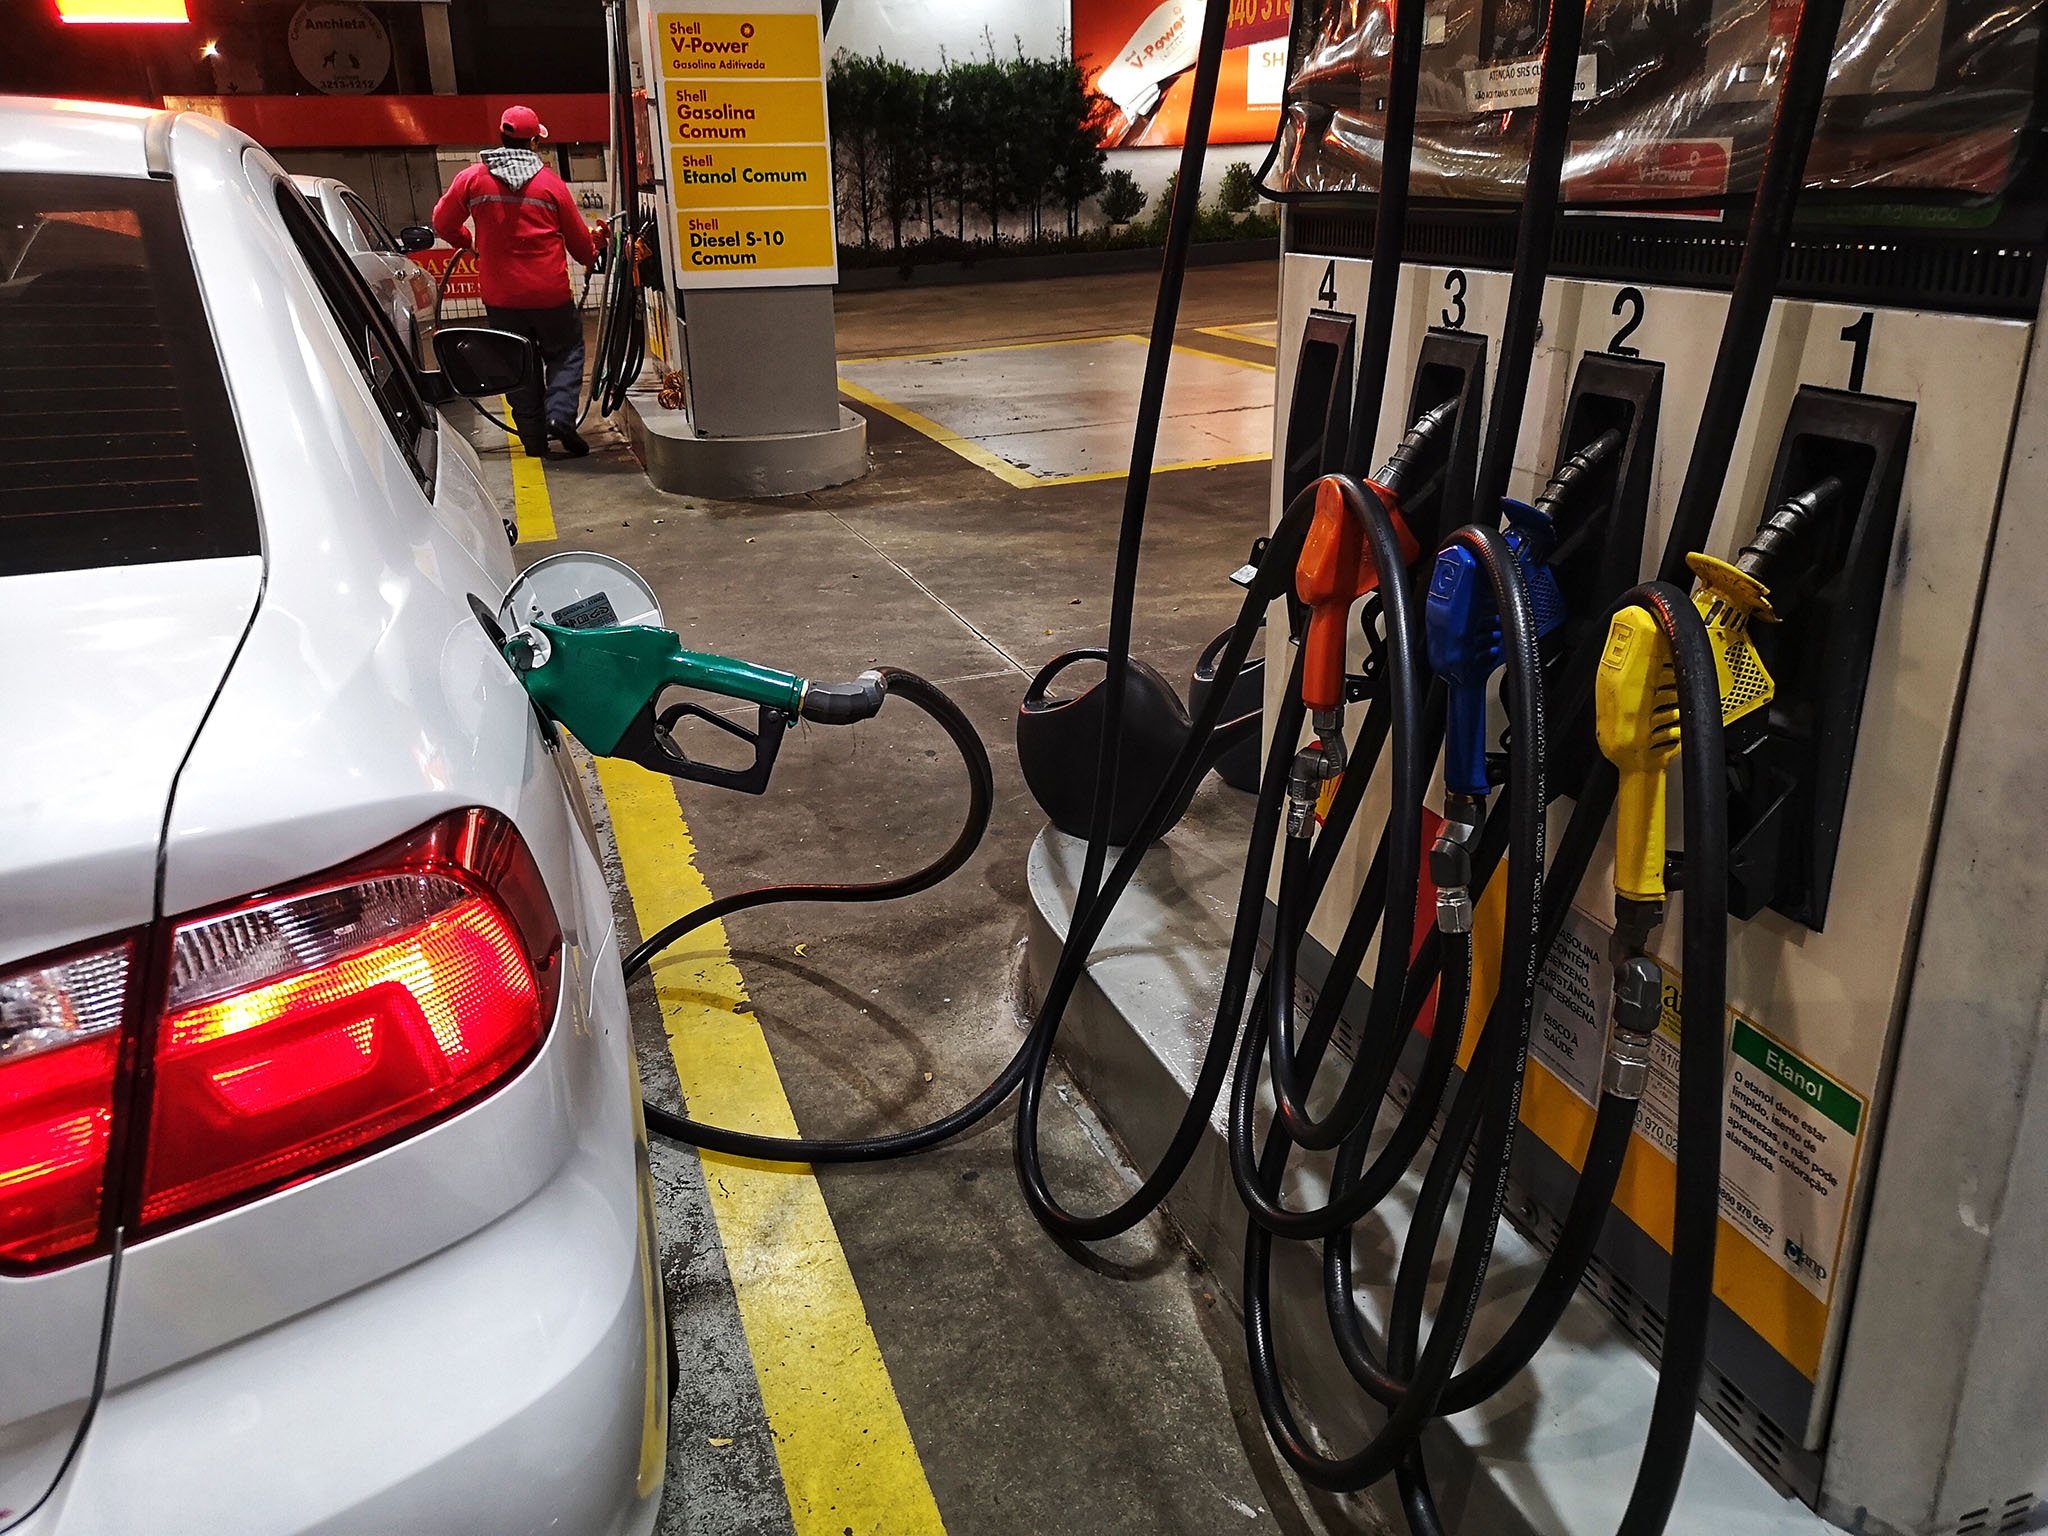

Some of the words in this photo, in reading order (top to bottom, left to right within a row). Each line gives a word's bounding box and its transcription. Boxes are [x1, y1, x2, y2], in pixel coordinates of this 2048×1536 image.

[305, 18, 366, 30] Anchieta
[669, 21, 701, 35] Shell
[671, 37, 749, 53] V-Power
[1130, 15, 1185, 69] V-Power
[673, 59, 716, 70] Gasolina
[719, 60, 766, 70] Aditivada
[1516, 66, 1531, 78] SRS
[676, 90, 707, 102] Shell
[677, 104, 756, 120] Gasolina
[679, 124, 746, 139] Comum
[682, 155, 713, 167] Shell
[683, 168, 737, 184] Etanol
[742, 168, 807, 183] Comum
[688, 219, 719, 231] Shell
[690, 231, 741, 248] Diesel
[746, 231, 785, 246] S-10
[692, 251, 757, 266] Comum
[438, 282, 476, 295] OLTE
[1318, 260, 1337, 308] 4
[1442, 269, 1467, 329] 3
[1608, 287, 1645, 357] 2
[1840, 312, 1874, 393] 1
[1608, 628, 1630, 664] E
[1552, 940, 1589, 973] CONTÉM
[1559, 929, 1600, 965] ASOLINA
[1544, 1012, 1571, 1040] RISCO
[1571, 1032, 1579, 1047] À
[1765, 1049, 1824, 1101] Etanol
[1735, 1071, 1743, 1082] O
[1744, 1080, 1774, 1105] etanol
[1775, 1102, 1800, 1124] deve
[1801, 1121, 1828, 1143] estar
[1645, 1117, 1664, 1139] 970
[1771, 1113, 1801, 1142] isento
[1803, 1139, 1817, 1154] de
[1725, 1130, 1775, 1173] alaranjada.
[1730, 1099, 1781, 1145] impurezas,
[1782, 1140, 1789, 1150] e
[1791, 1147, 1810, 1165] não
[1811, 1163, 1838, 1187] pode
[1727, 1115, 1778, 1157] apresentar
[1779, 1155, 1828, 1196] coloração
[1736, 1202, 1752, 1220] 970
